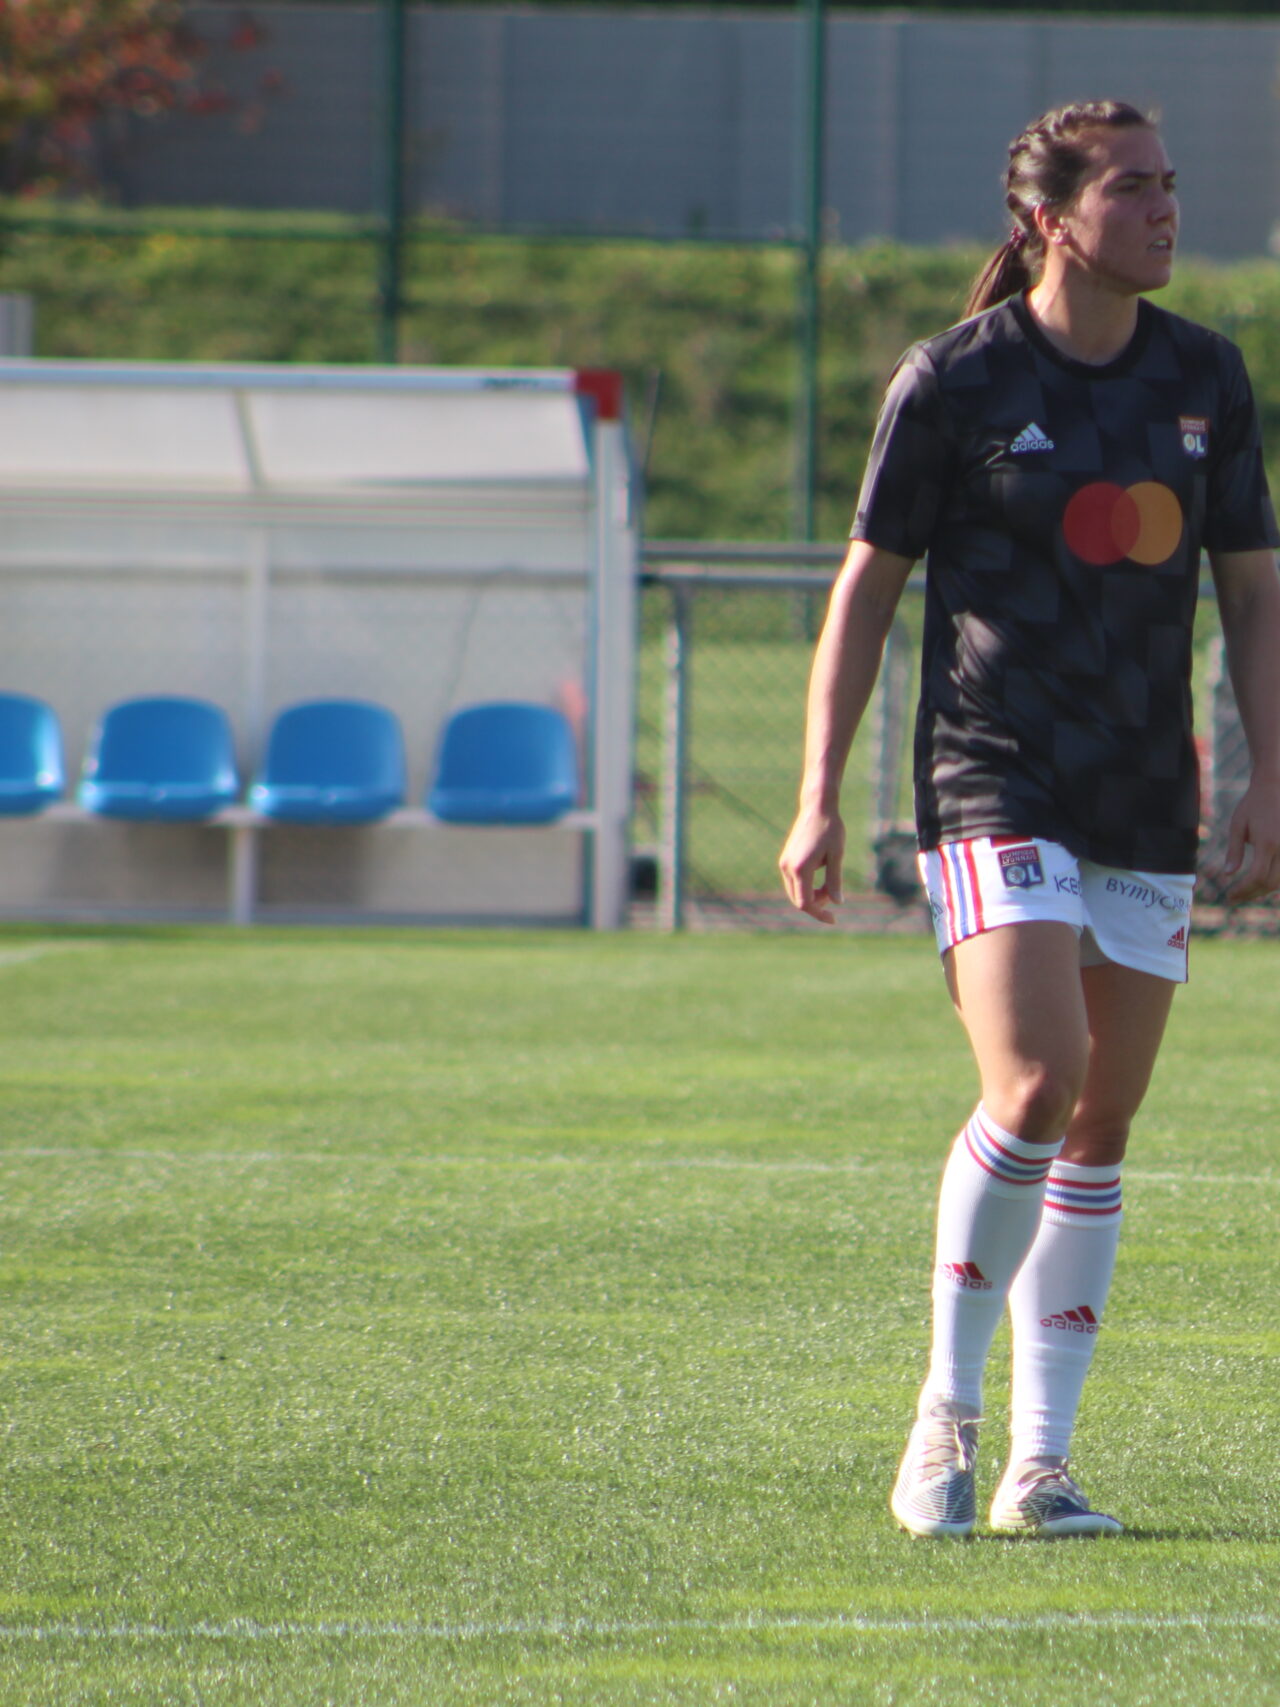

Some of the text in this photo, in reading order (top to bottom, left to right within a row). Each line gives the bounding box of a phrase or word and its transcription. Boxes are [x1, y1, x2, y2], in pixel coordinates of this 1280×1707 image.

[1010, 438, 1055, 453] adidas
[1183, 433, 1205, 453] OL
[1006, 864, 1041, 885] OL
[1053, 875, 1082, 897] KE
[938, 1265, 993, 1291] adidas
